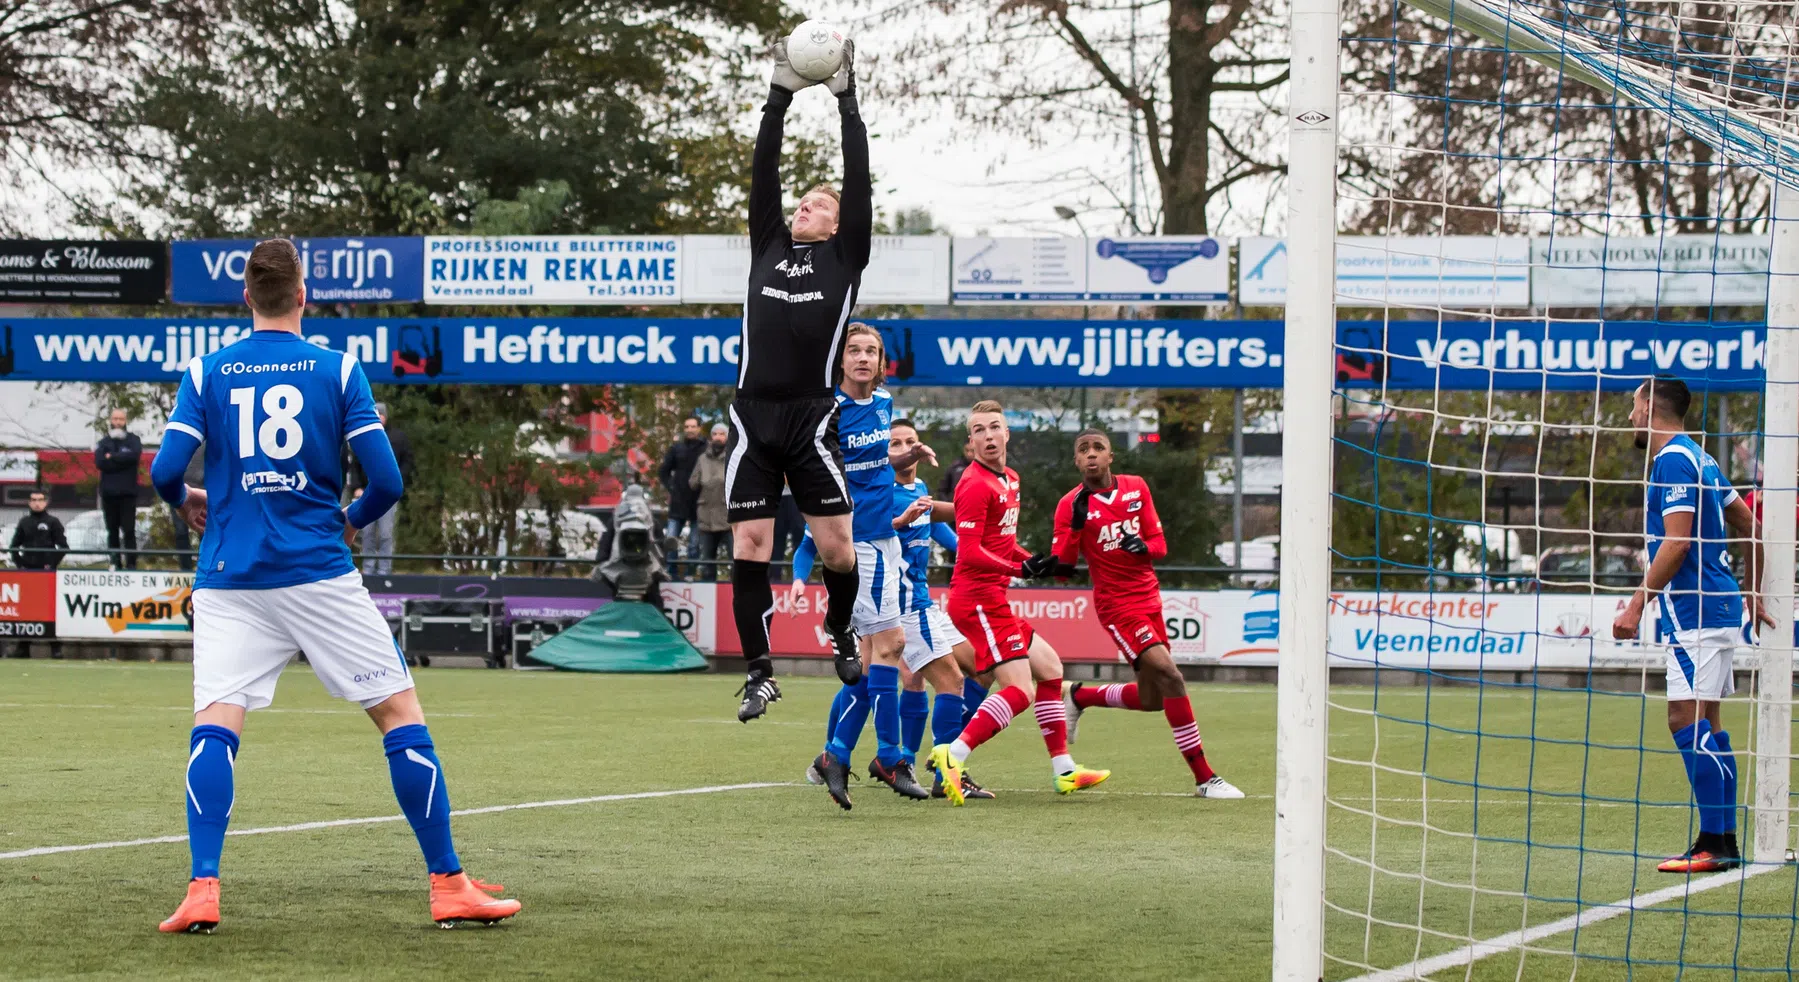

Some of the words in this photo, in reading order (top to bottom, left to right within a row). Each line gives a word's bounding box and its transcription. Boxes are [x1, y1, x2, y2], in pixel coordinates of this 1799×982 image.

[64, 247, 154, 269] Blossom
[431, 241, 560, 252] PROFESSIONELE
[570, 241, 676, 252] BELETTERING
[332, 240, 394, 288] rijn
[431, 258, 527, 282] RIJKEN
[544, 258, 676, 281] REKLAME
[312, 288, 392, 300] businessclub
[432, 285, 534, 296] Veenendaal
[462, 325, 676, 365] Heftruck
[221, 360, 317, 375] GOconnectIT
[230, 384, 304, 460] 18
[64, 574, 135, 586] SCHILDERS-
[142, 576, 157, 587] EN
[64, 593, 122, 619] Wim
[130, 601, 172, 620] van
[1330, 593, 1499, 619] Truckcenter
[16, 623, 45, 636] 1700
[1355, 628, 1526, 655] Veenendaal
